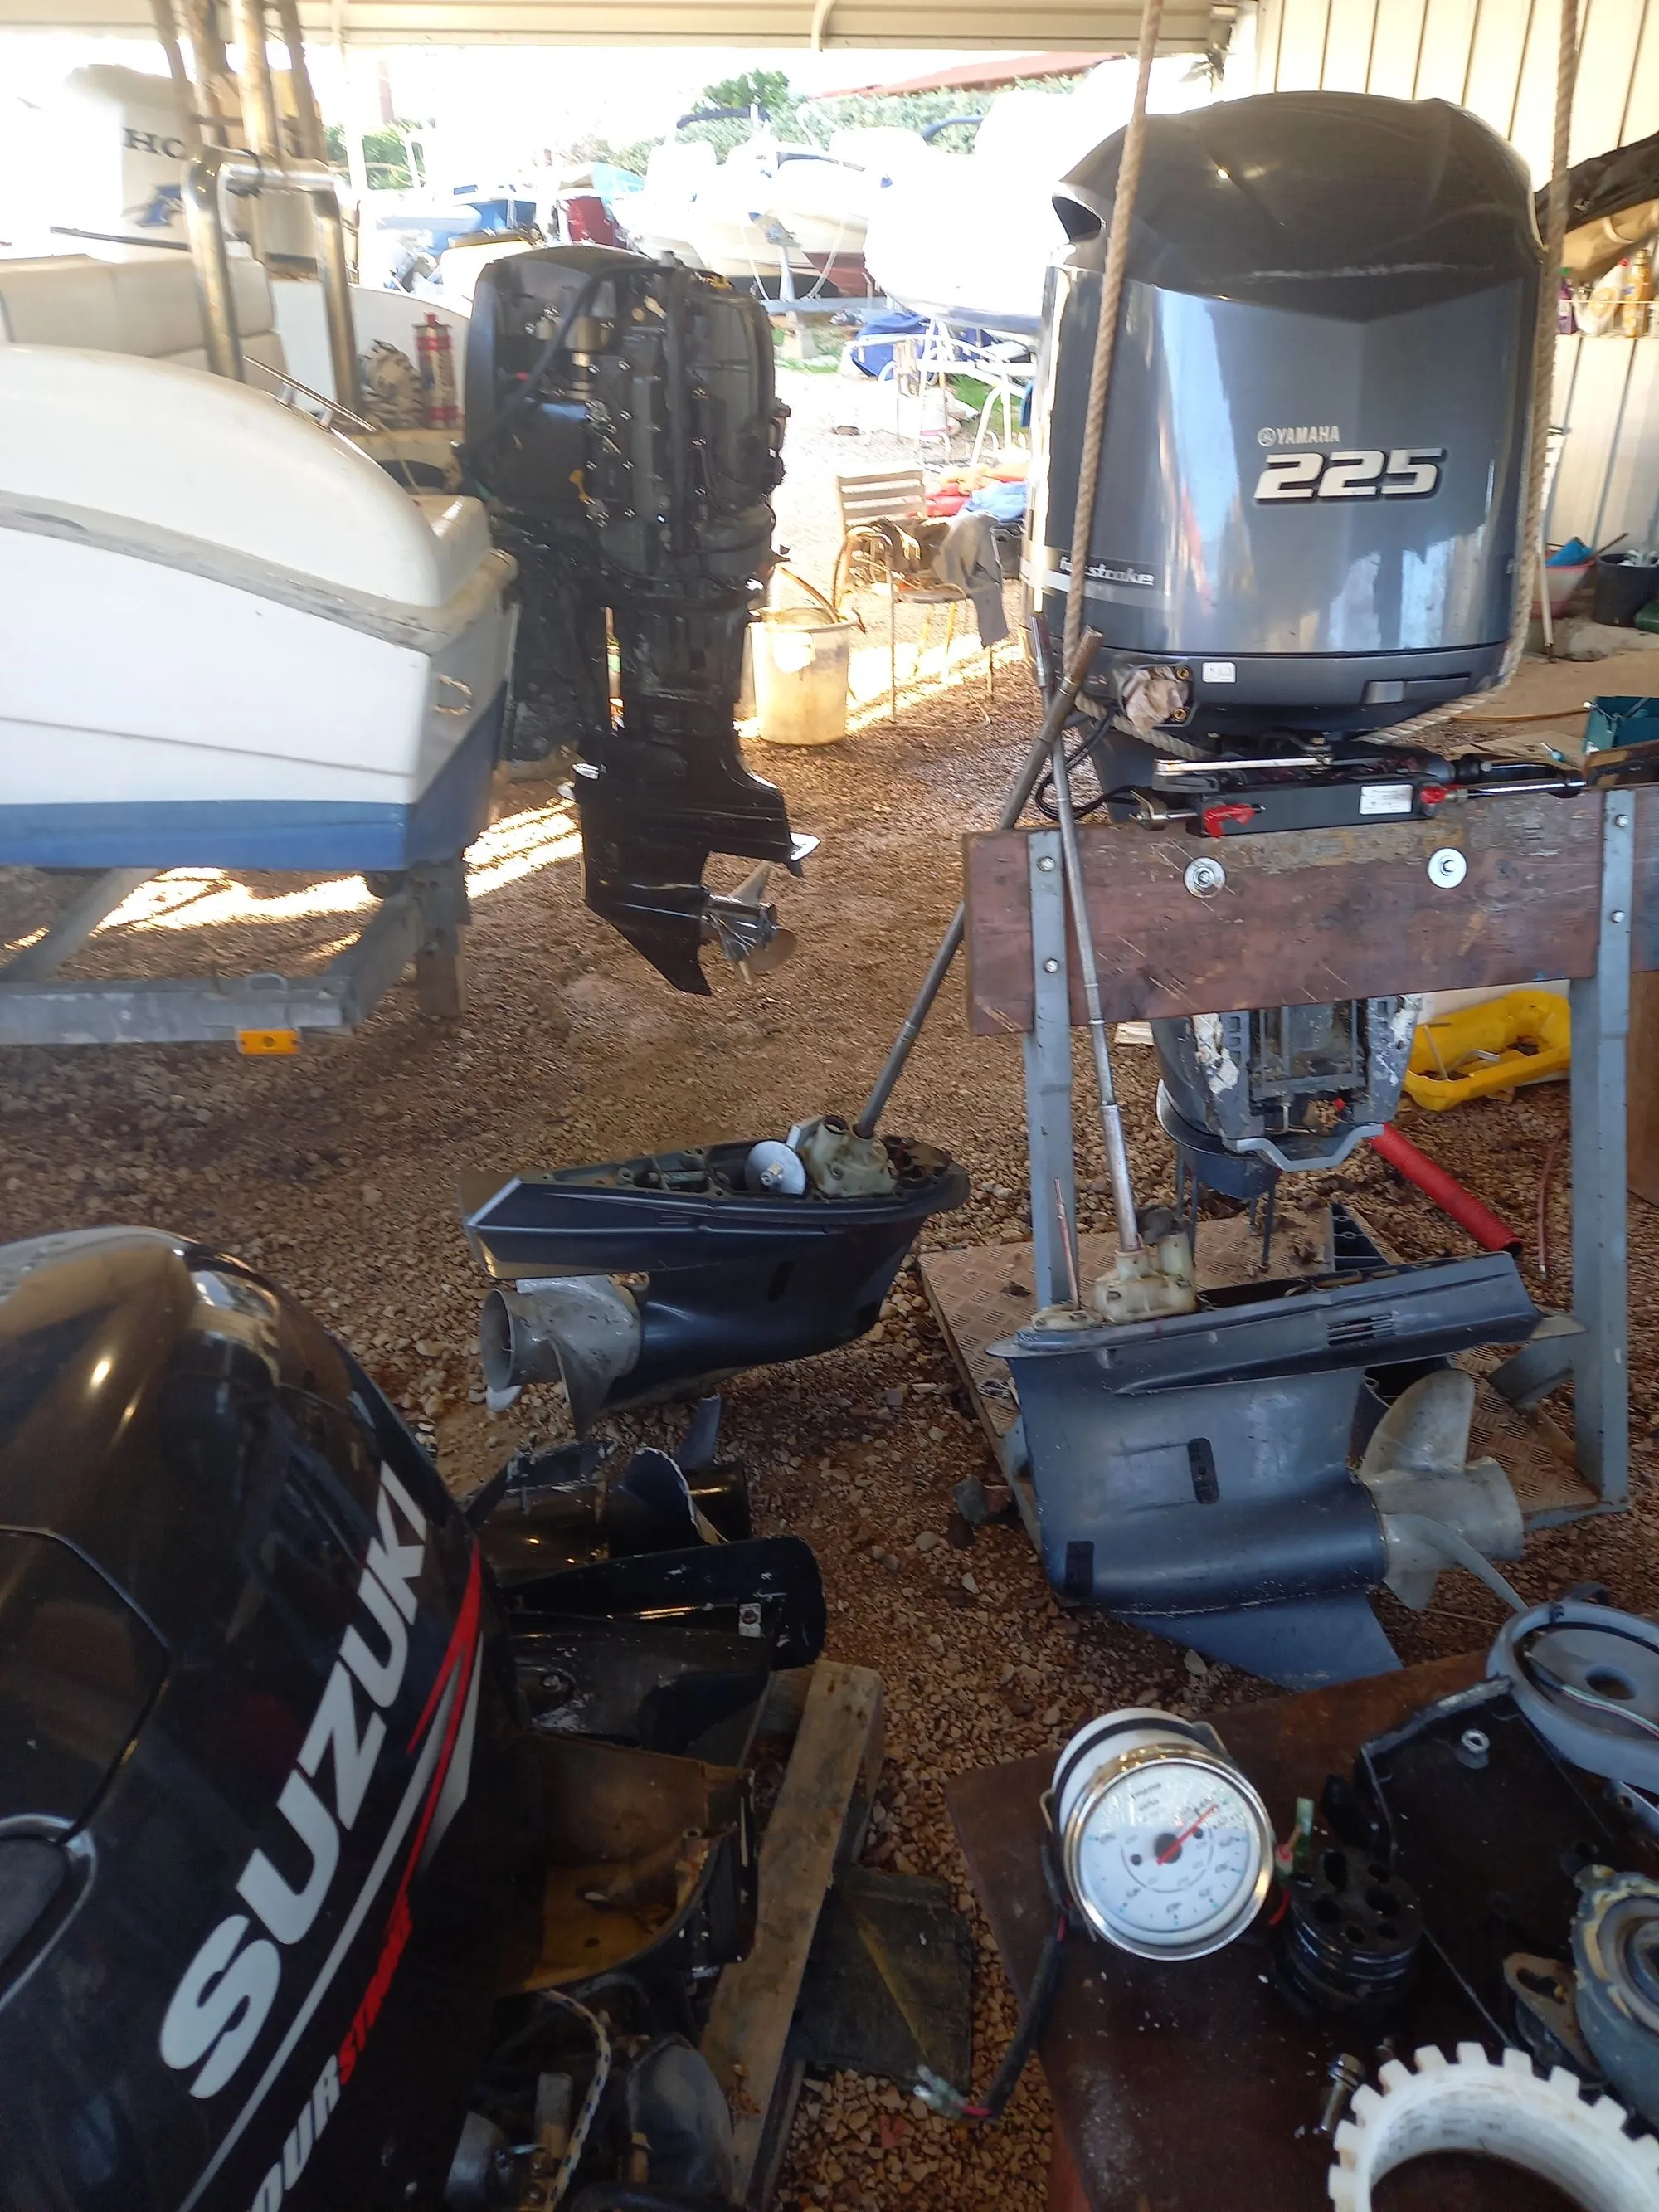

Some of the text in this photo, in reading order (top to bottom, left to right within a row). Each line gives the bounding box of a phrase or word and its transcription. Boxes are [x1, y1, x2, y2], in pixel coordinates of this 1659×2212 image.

[1276, 425, 1340, 445] YAMAHA
[1253, 447, 1444, 499] 225
[158, 1460, 427, 2099] SUZUKI
